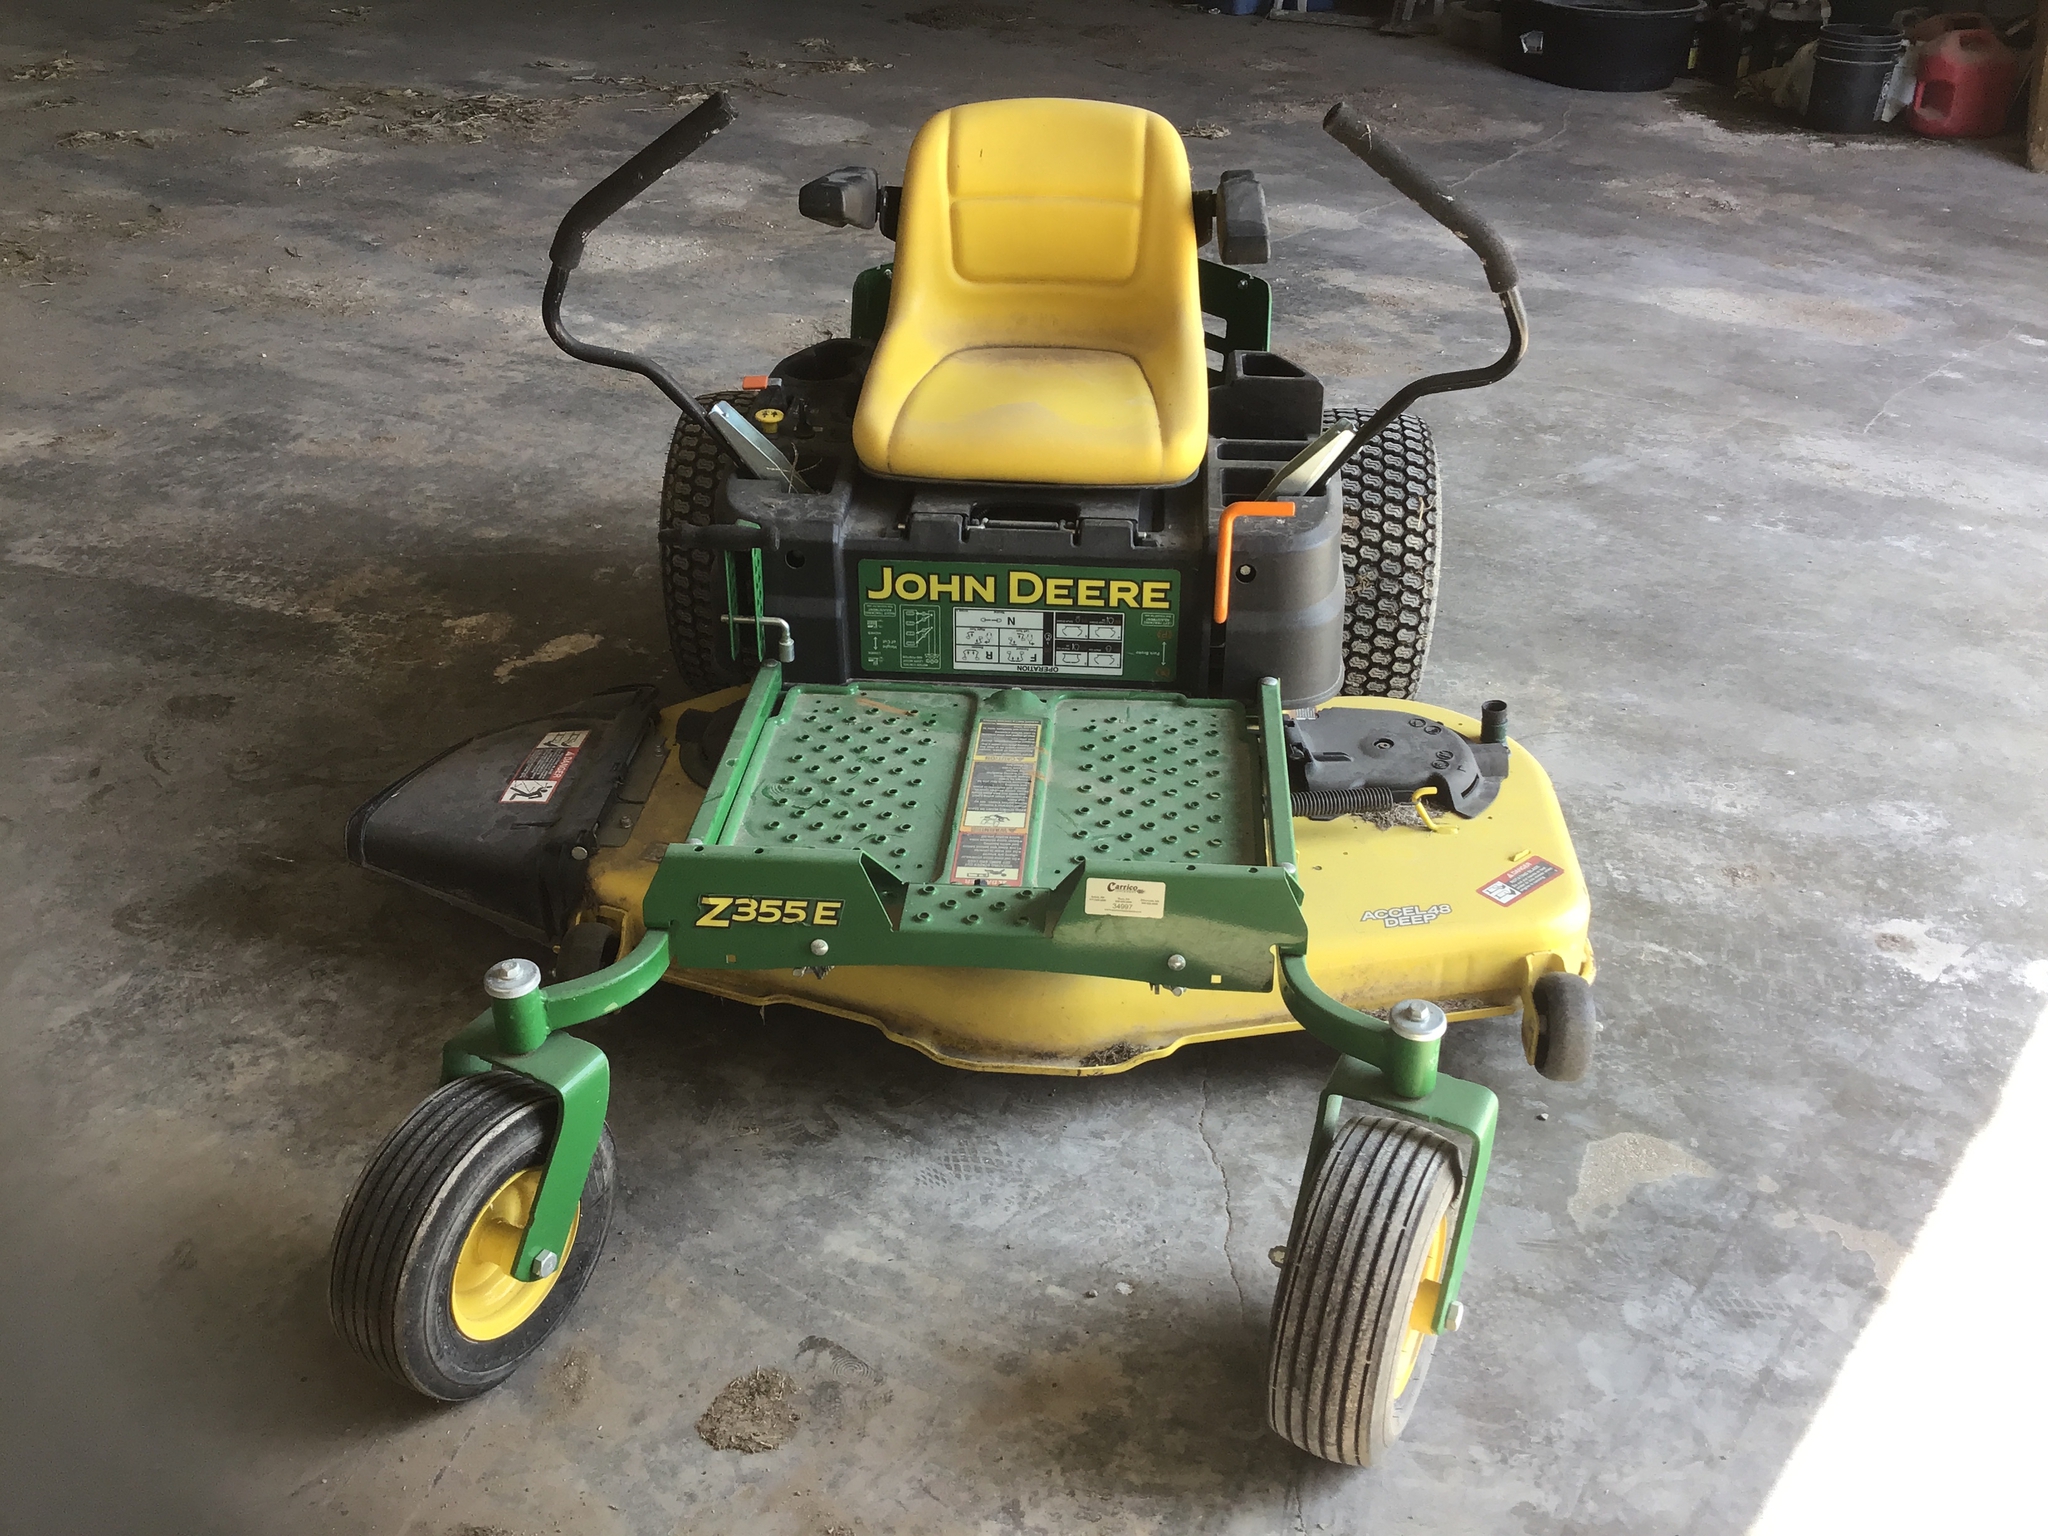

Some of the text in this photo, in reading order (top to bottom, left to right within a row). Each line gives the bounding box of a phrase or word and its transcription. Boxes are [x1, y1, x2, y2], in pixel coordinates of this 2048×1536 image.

[867, 566, 1171, 610] JOHN DEERE
[1007, 616, 1015, 625] N
[985, 651, 993, 659] R
[1029, 653, 1037, 662] F
[1016, 665, 1059, 673] OPERATION
[1384, 913, 1438, 928] DEEP
